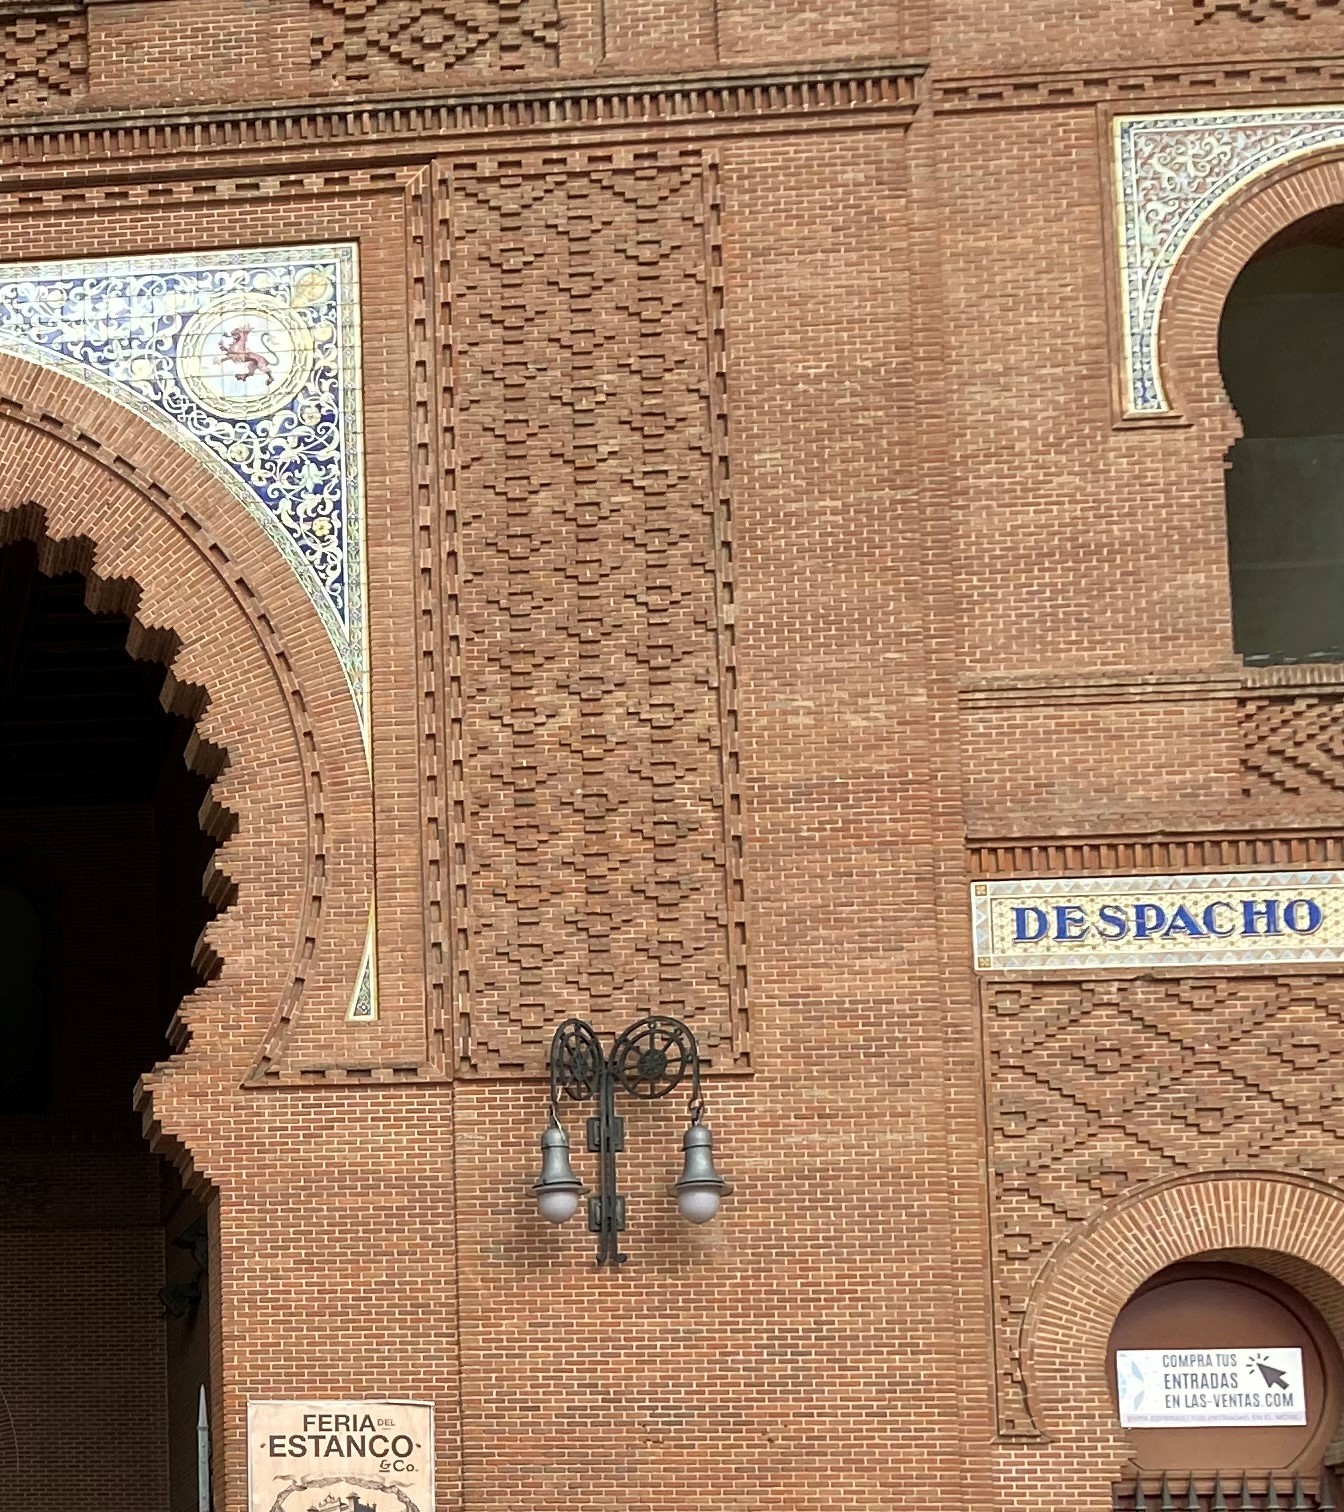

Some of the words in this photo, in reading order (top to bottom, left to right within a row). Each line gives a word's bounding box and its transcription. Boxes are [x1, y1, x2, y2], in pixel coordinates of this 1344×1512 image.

[1012, 900, 1323, 942] DESPACHO
[1163, 1354, 1212, 1368] COMPRA
[1216, 1354, 1237, 1367] TUS
[1164, 1373, 1238, 1390] ENTRADAS
[1165, 1395, 1180, 1408] EN
[303, 1414, 376, 1432] FERIA
[377, 1418, 396, 1426] DEL
[269, 1435, 413, 1458] ESTANCO
